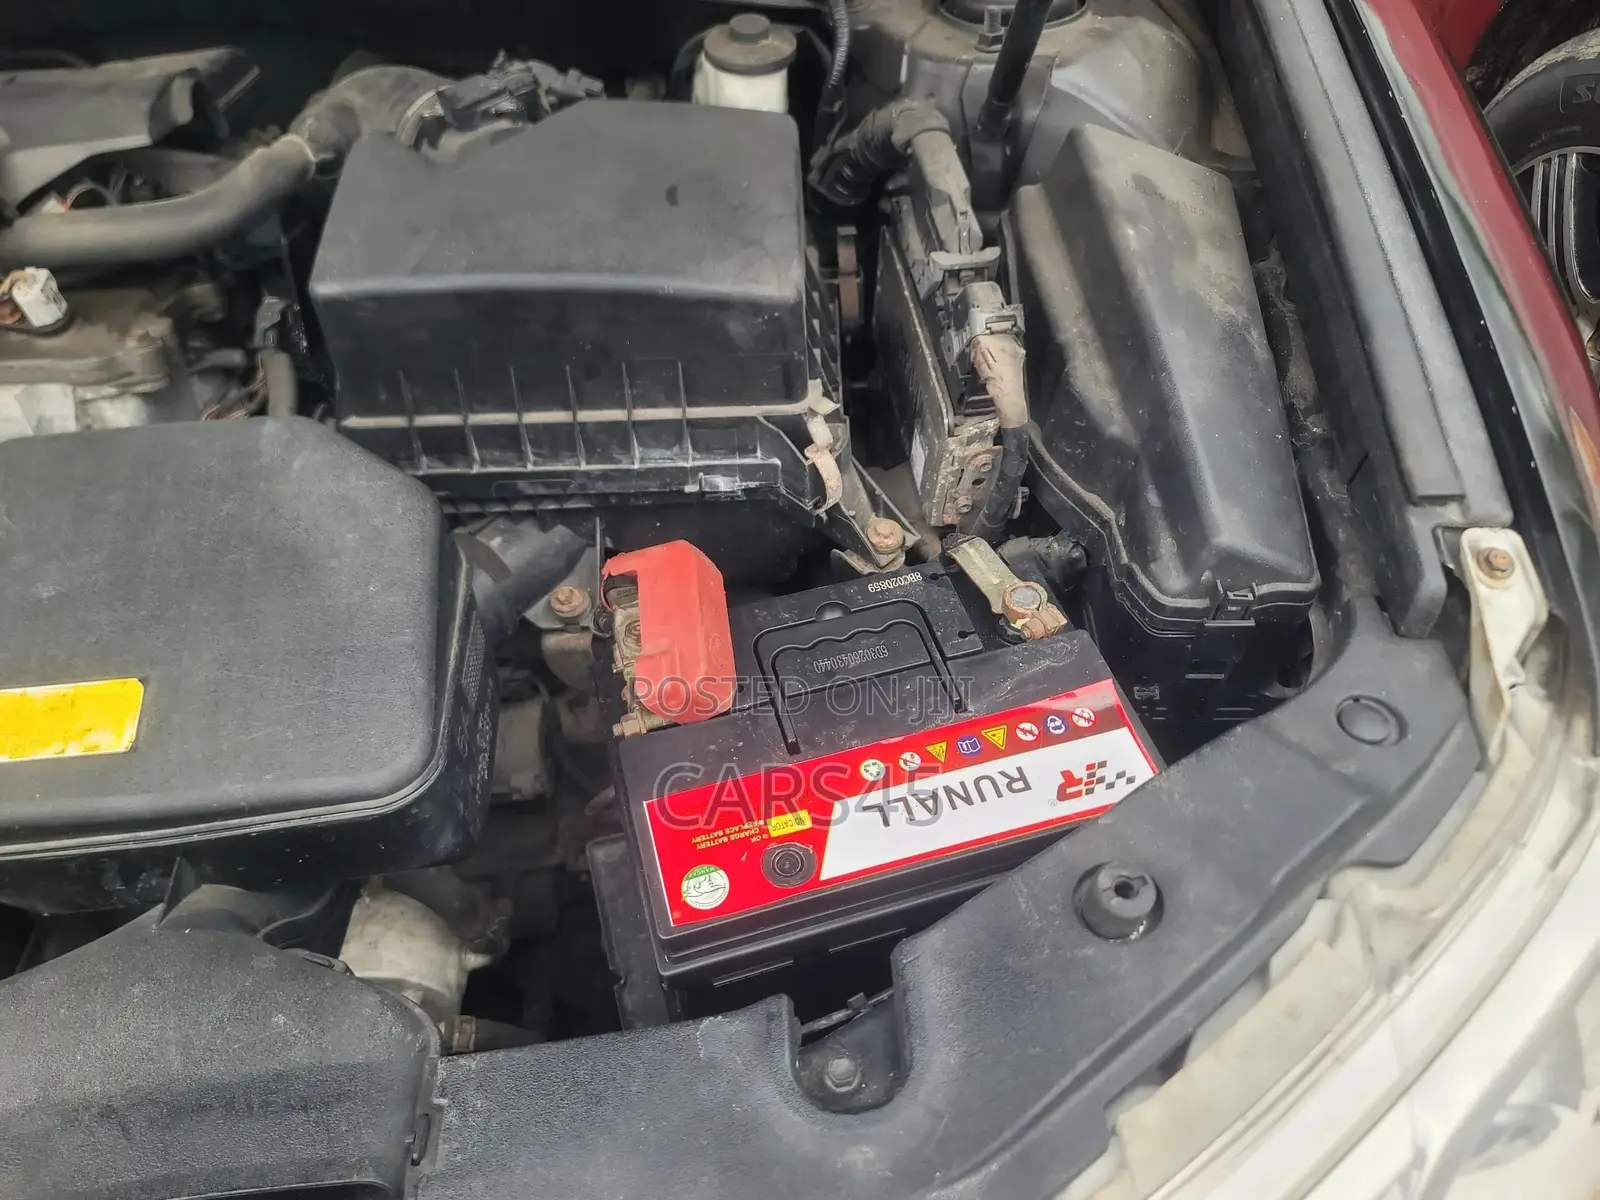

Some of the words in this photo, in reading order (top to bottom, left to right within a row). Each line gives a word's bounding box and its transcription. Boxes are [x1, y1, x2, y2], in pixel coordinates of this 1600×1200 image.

[868, 571, 922, 593] 8BC020859
[863, 766, 1031, 829] RUNALL
[725, 820, 758, 834] REPLACE
[691, 830, 723, 844] BATTERY
[728, 828, 760, 841] CHARGE
[750, 834, 762, 843] OK
[696, 835, 728, 850] BATTERY
